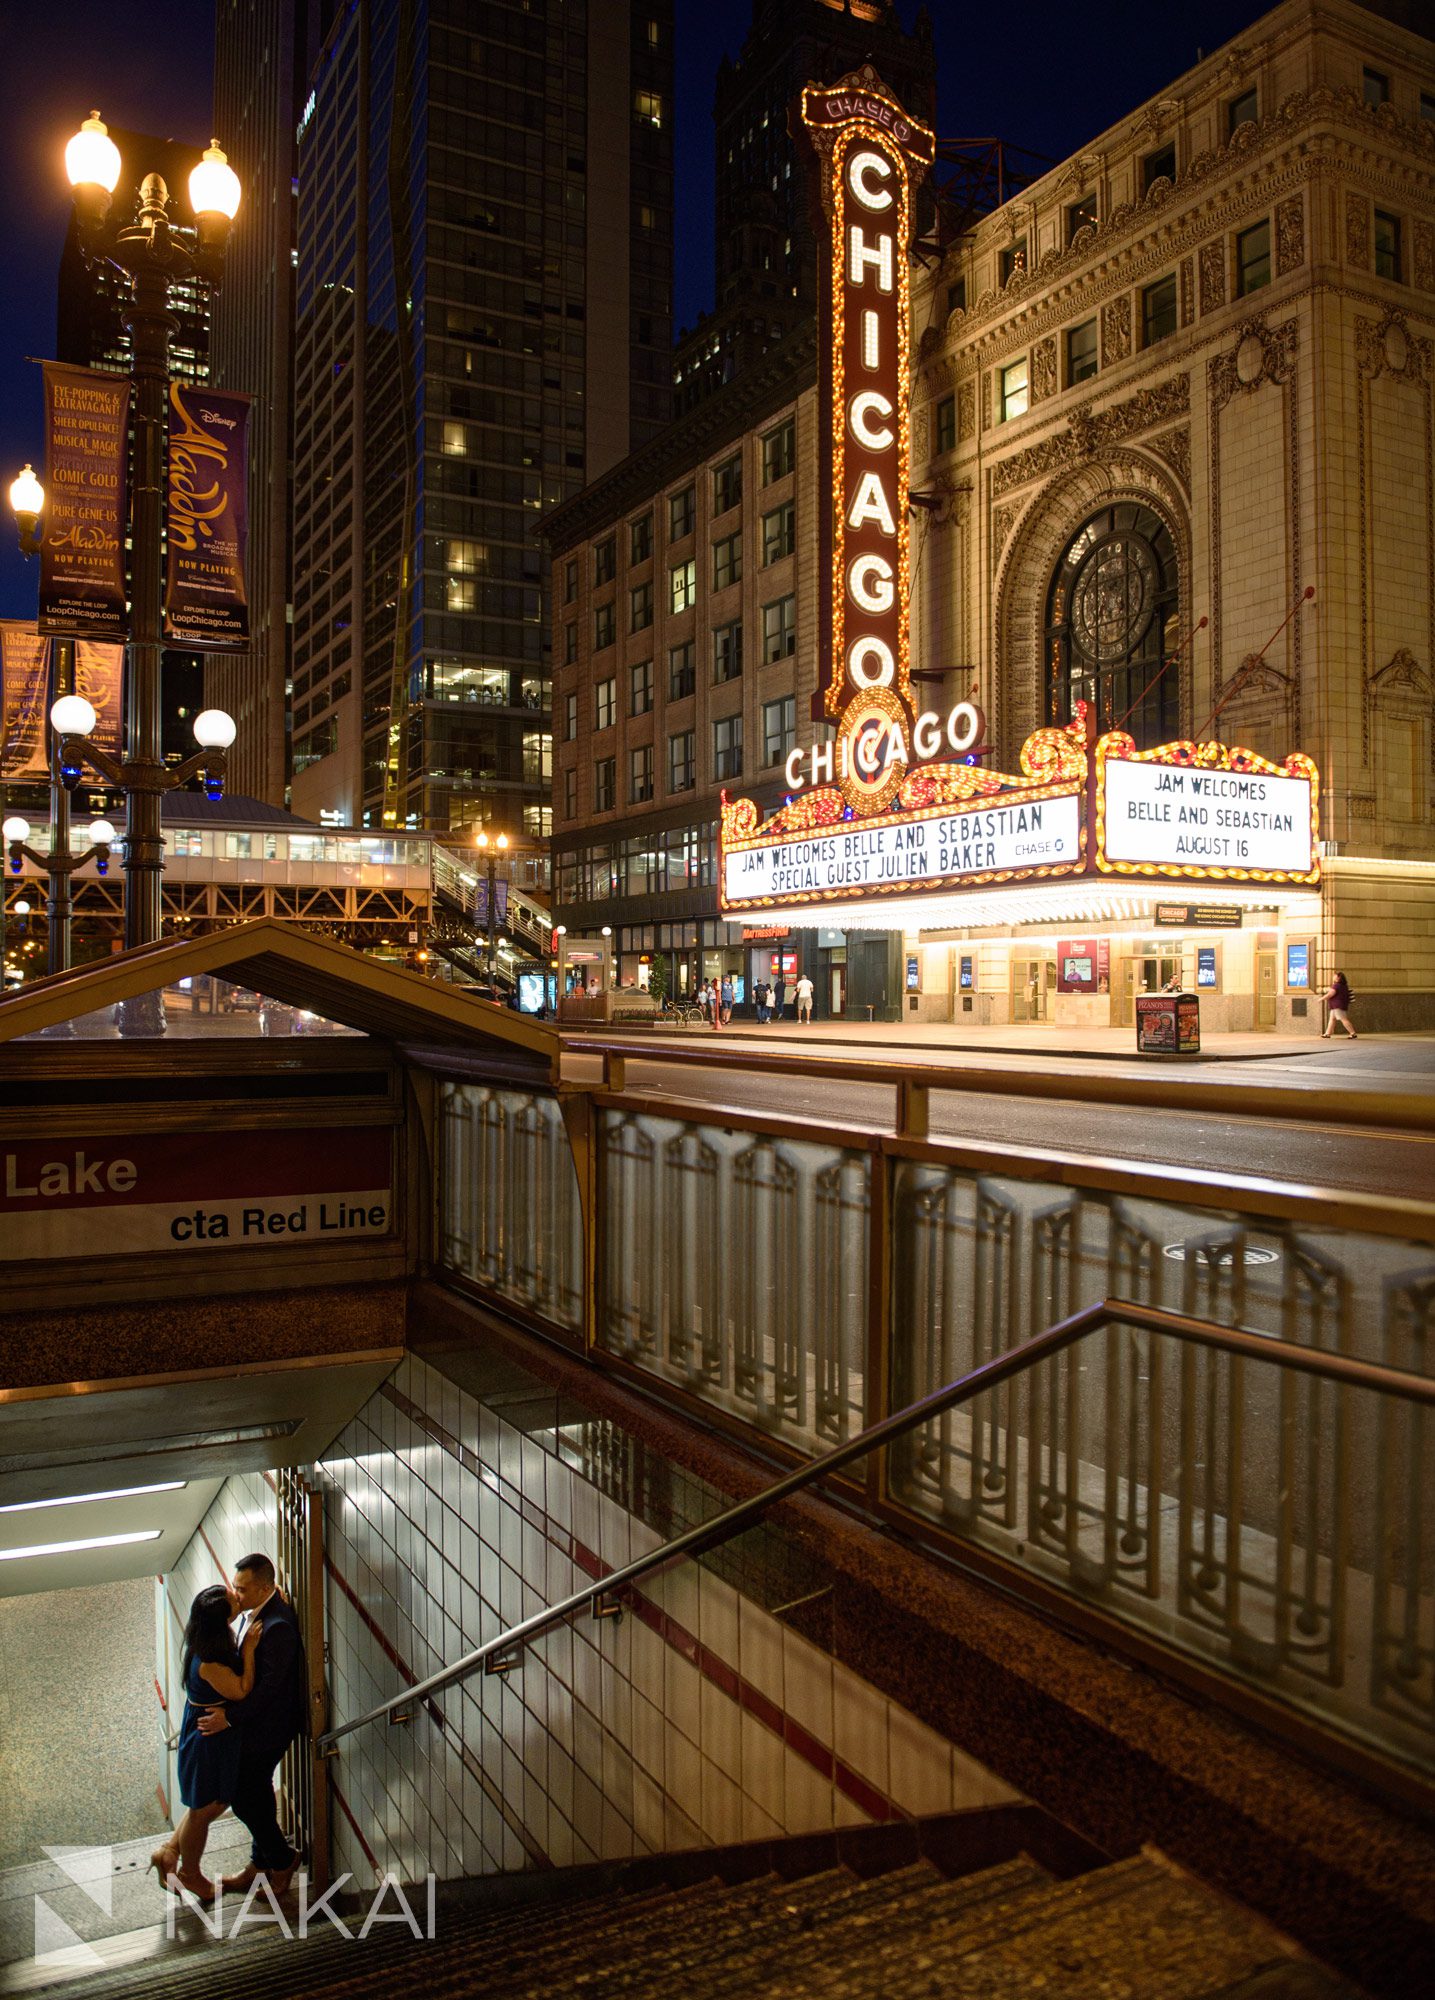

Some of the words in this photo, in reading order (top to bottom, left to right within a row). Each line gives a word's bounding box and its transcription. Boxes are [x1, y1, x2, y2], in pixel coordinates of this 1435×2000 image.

[826, 98, 893, 127] CHASE
[54, 385, 110, 404] EYE-POPPING
[113, 393, 120, 405] &
[54, 397, 120, 416] EXTRAVAGANT!
[54, 416, 76, 428] SHEER
[79, 420, 119, 434] OPULENCE!
[849, 152, 896, 688] CHICAGO
[53, 434, 88, 449] MUSICAL
[92, 439, 119, 453] MAGIC
[168, 381, 228, 551] Aladdin
[53, 468, 87, 484] COMIC
[90, 472, 118, 488] GOLD
[52, 504, 77, 518] PURE
[79, 507, 118, 522] GENIE-US
[49, 525, 119, 551] Aladdin
[54, 554, 74, 563] NOW
[77, 556, 115, 568] PLAYING
[179, 560, 197, 571] NOW
[200, 563, 236, 576] PLAYING
[46, 605, 120, 620] LoopChicago.com
[59, 599, 82, 607] EXPLORE
[183, 605, 205, 613] EXPLORE
[172, 613, 242, 628] LoopChicago.com
[786, 701, 979, 790] CHICAGO
[1154, 773, 1184, 793] JAM
[1191, 777, 1266, 801] WELCOMES
[1128, 801, 1171, 822] BELLE
[1178, 806, 1208, 825] AND
[1216, 809, 1293, 832] SEBASTIAN
[742, 851, 764, 872] JAM
[772, 840, 836, 868] WELCOMES
[845, 831, 885, 858] BELLE
[895, 825, 925, 851] AND
[938, 804, 1042, 845] SEBASTIAN
[1176, 835, 1230, 856] AUGUST
[1236, 839, 1249, 857] 16
[1015, 841, 1051, 856] CHASE
[771, 865, 820, 891] SPECIAL
[828, 859, 870, 884] GUEST
[877, 850, 928, 878] JULIEN
[940, 842, 996, 871] BAKER
[5, 1151, 138, 1198] Lake
[170, 1210, 230, 1242] cta
[242, 1205, 307, 1236] Red
[320, 1202, 386, 1230] Line
